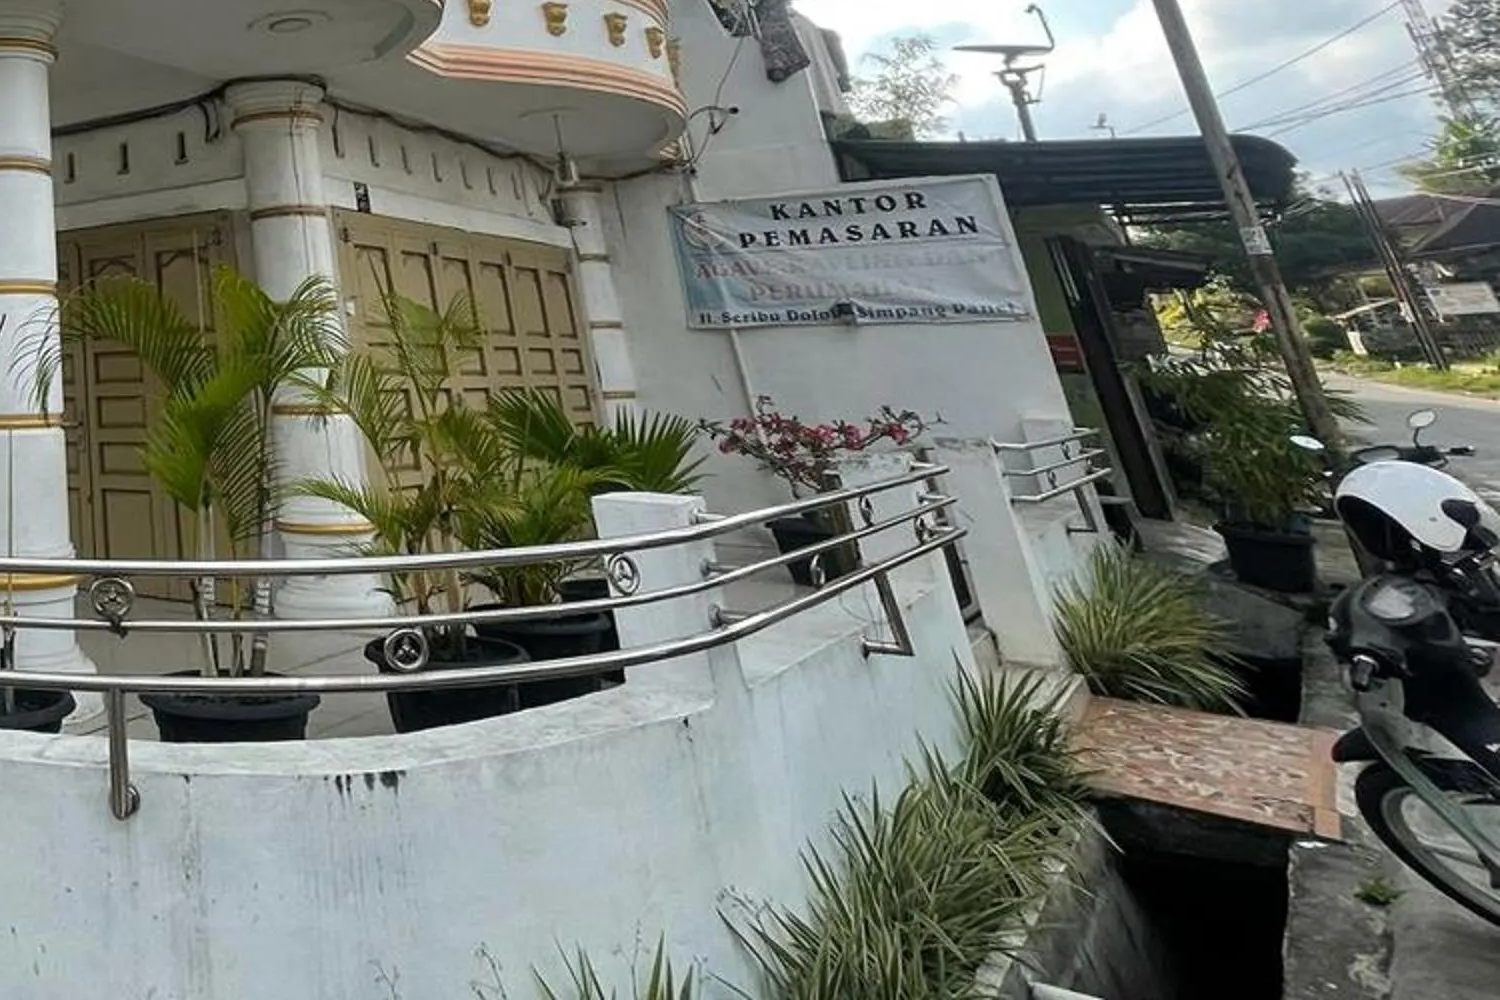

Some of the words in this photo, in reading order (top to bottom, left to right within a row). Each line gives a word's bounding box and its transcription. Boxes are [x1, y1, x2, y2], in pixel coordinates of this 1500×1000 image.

[769, 191, 927, 220] KANTOR
[739, 195, 980, 249] PEMASARAN
[721, 310, 781, 324] Seribu
[857, 305, 948, 319] Simpang
